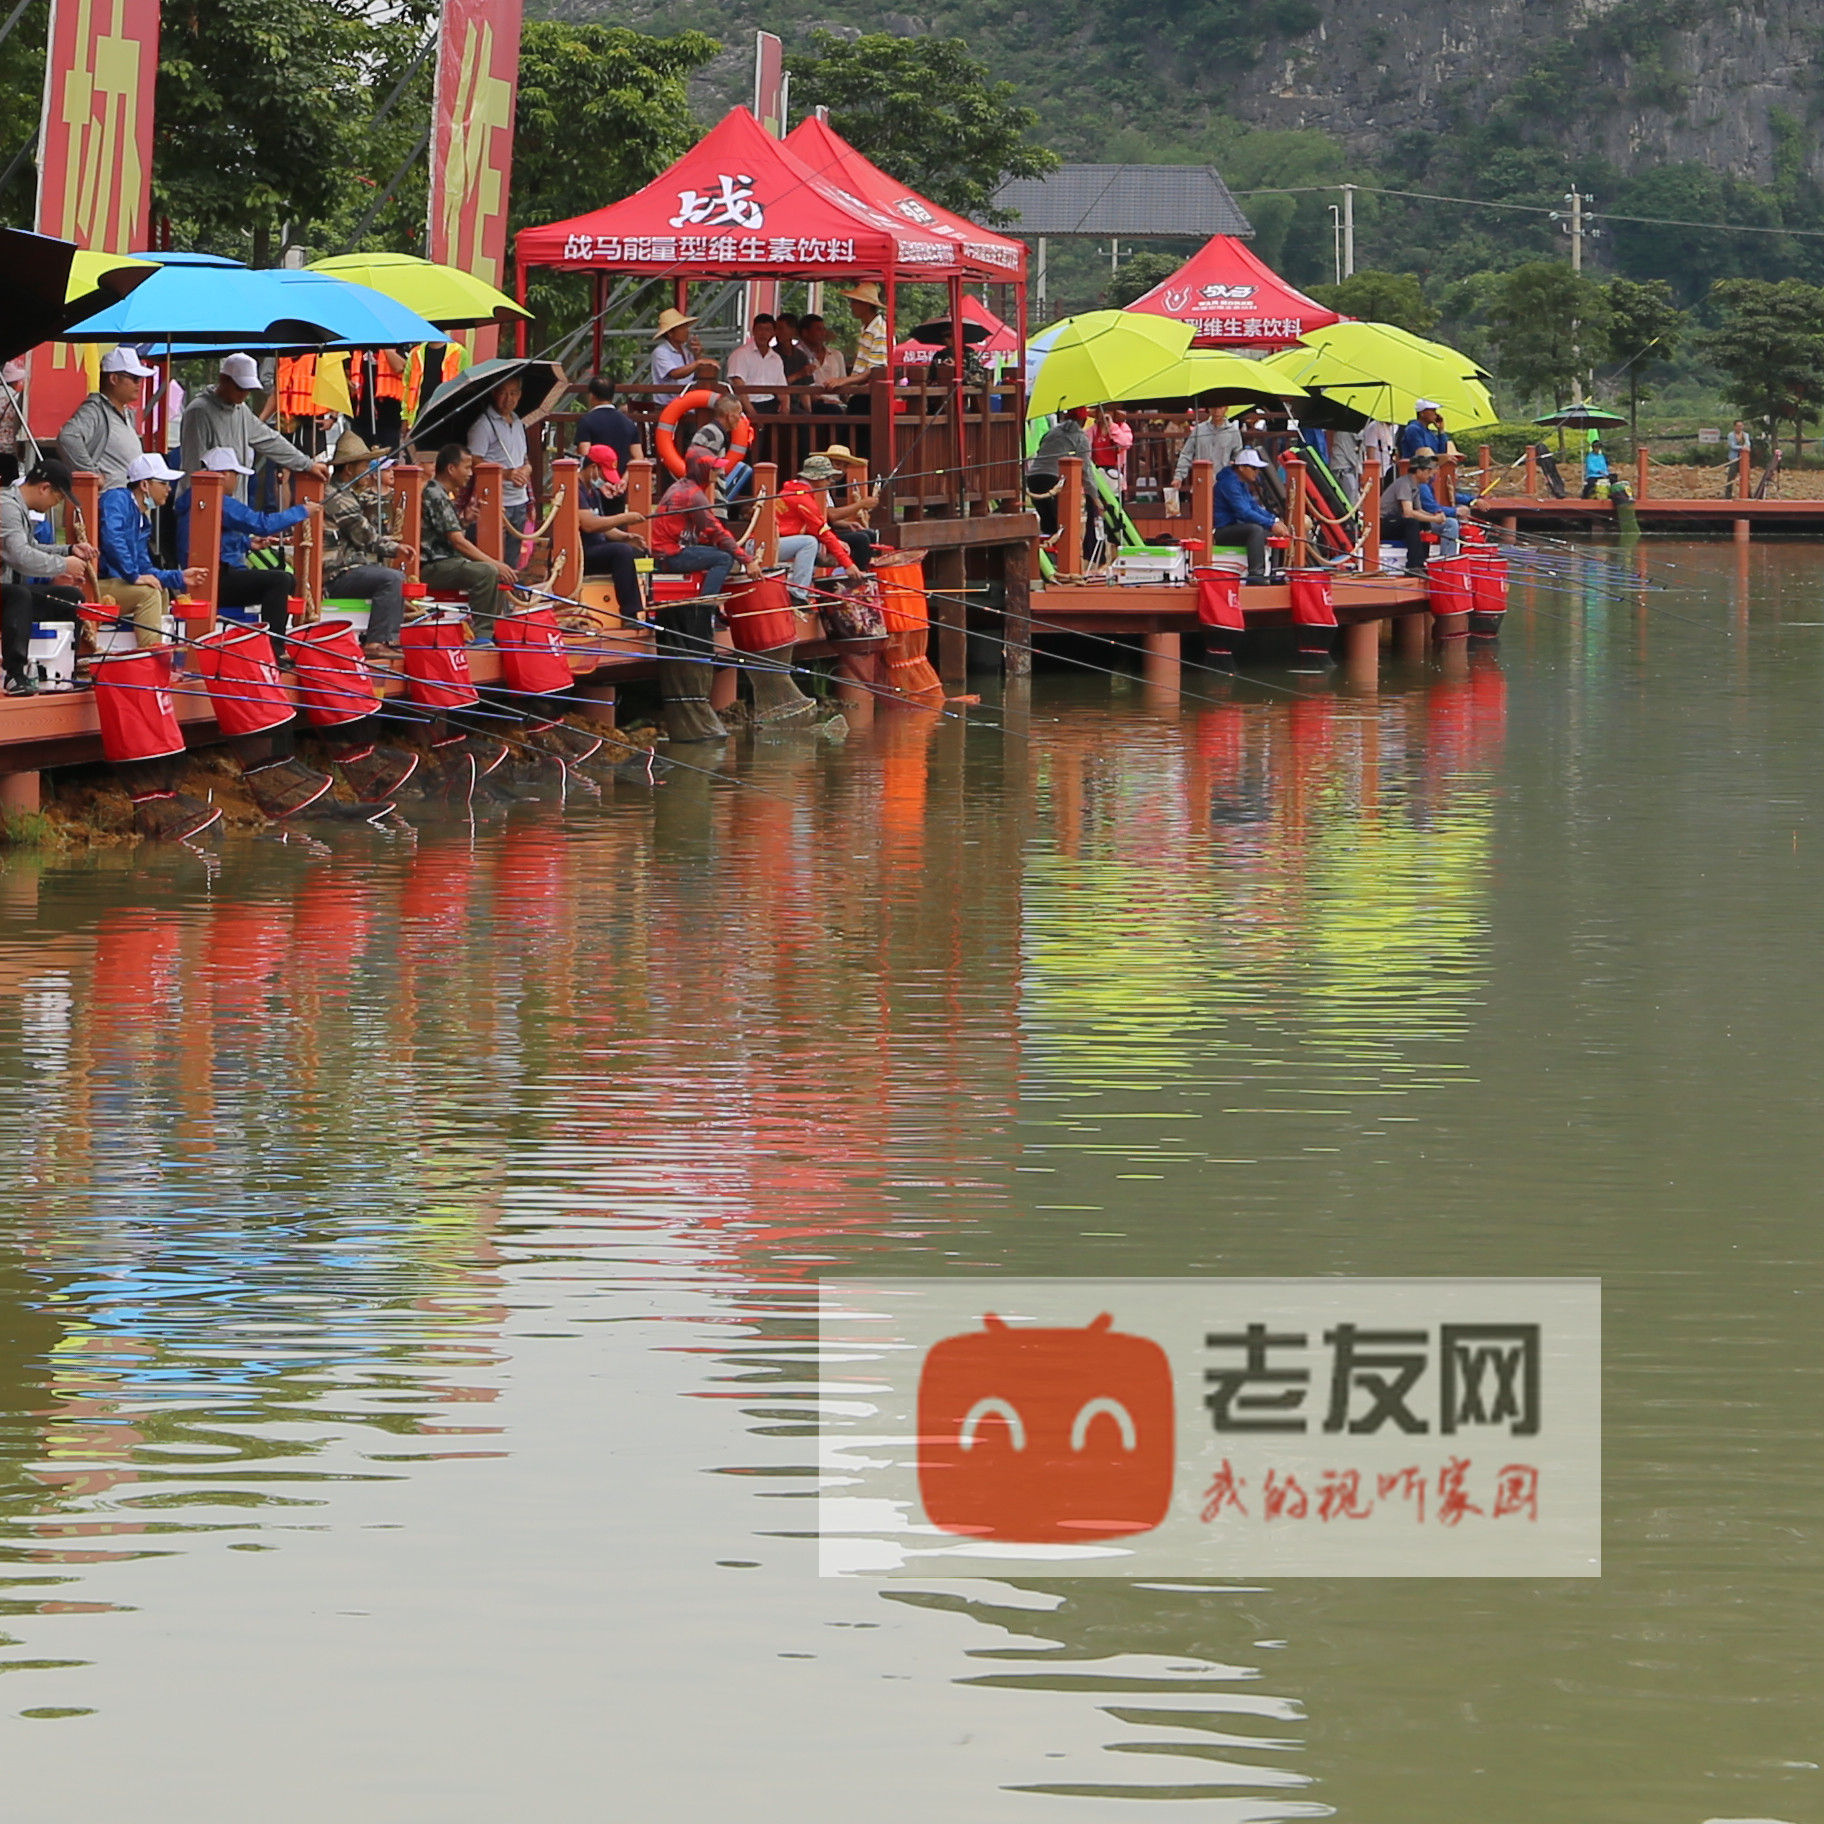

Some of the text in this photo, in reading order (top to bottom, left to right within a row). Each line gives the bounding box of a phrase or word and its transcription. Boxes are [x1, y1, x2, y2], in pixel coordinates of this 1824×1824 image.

[668, 174, 765, 230] 战
[563, 233, 858, 265] 战马能量型维生素饮料
[1177, 317, 1303, 339] 型维生素饮料
